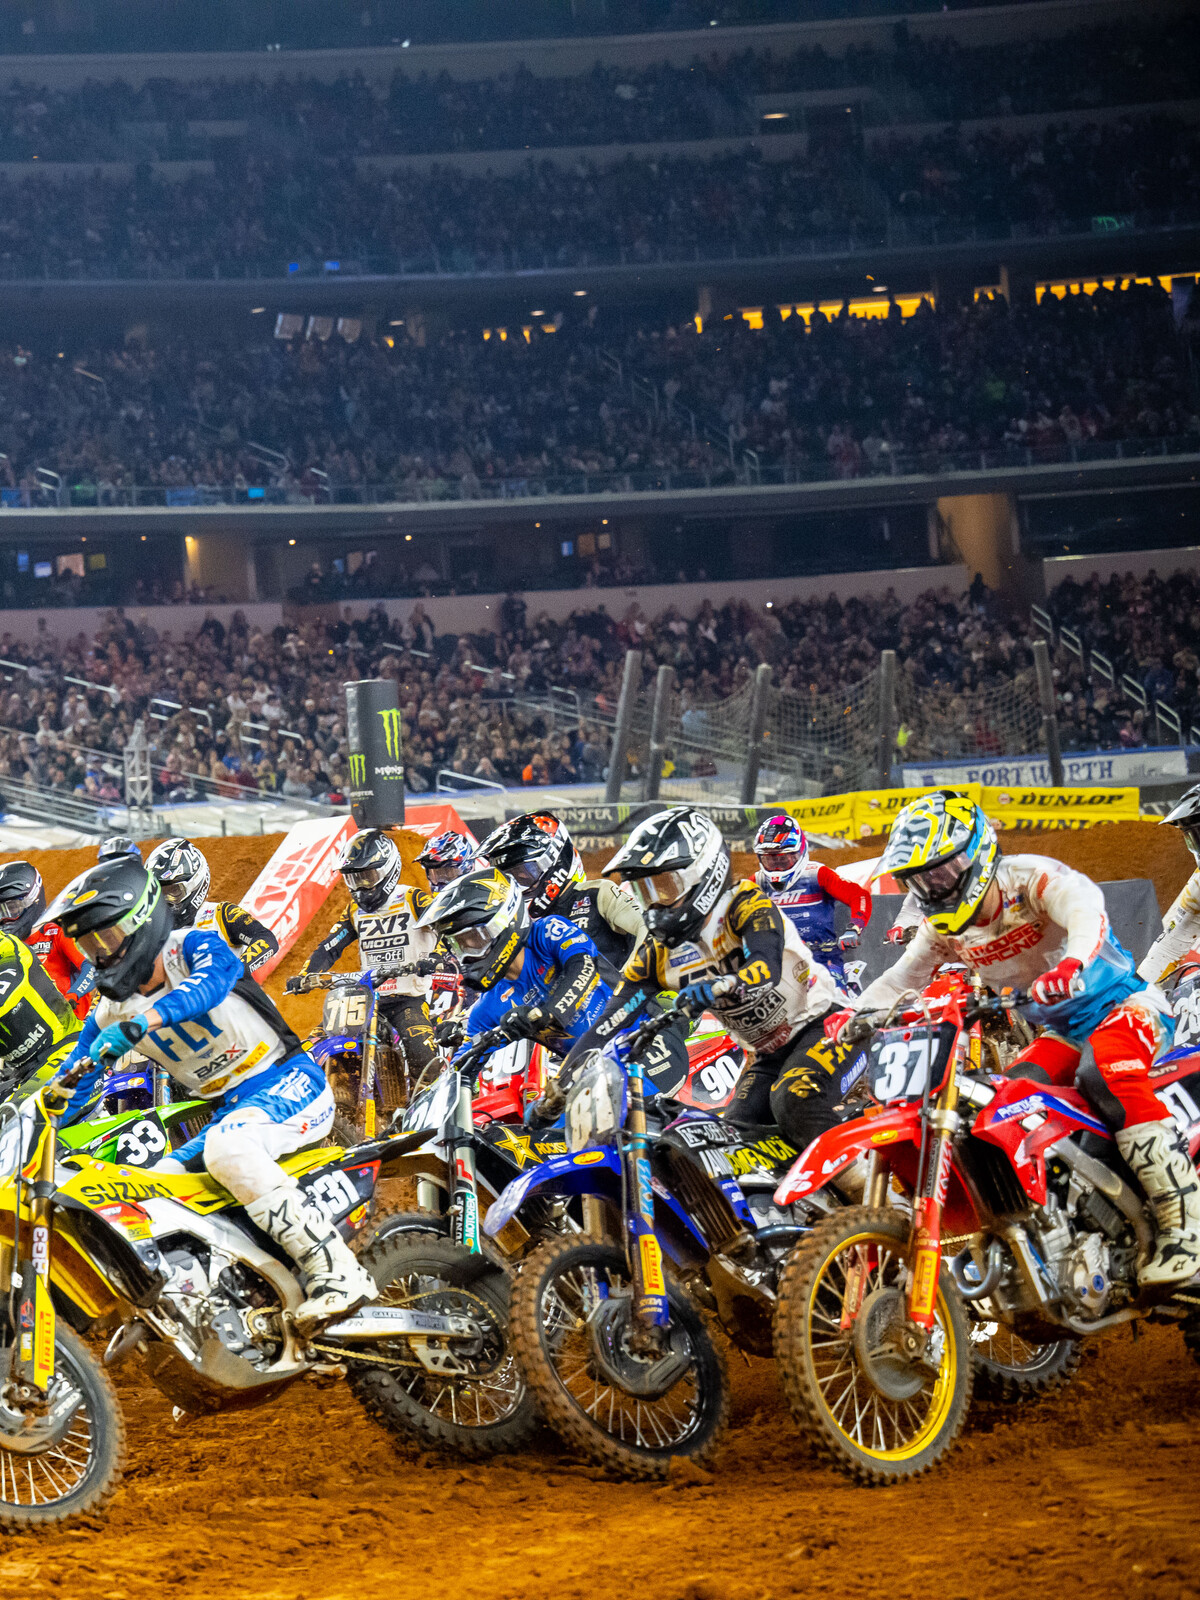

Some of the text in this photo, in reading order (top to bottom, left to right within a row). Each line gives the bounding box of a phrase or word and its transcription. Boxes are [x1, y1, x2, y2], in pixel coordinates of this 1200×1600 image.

[374, 765, 404, 776] MONS
[967, 768, 1026, 788] FORT
[792, 802, 845, 819] DUNLOP
[1019, 793, 1125, 807] DUNLOP
[534, 868, 568, 910] froth
[357, 912, 410, 937] FXR
[362, 935, 406, 950] MOTO
[966, 922, 1035, 958] MOOSE
[325, 994, 367, 1031] 715
[555, 988, 578, 1014] FLY
[596, 988, 646, 1036] CLUBMX
[148, 1011, 224, 1063] FLY
[645, 1034, 672, 1066] LY
[193, 1043, 246, 1080] BARX
[700, 1055, 740, 1101] 90
[875, 1038, 940, 1100] 37
[116, 1119, 167, 1166] 33
[80, 1181, 175, 1205] SUZUKI
[466, 1194, 478, 1240] MOTOREX
[643, 1240, 660, 1289] PIRELLI
[38, 1311, 53, 1371] PIRELLI
